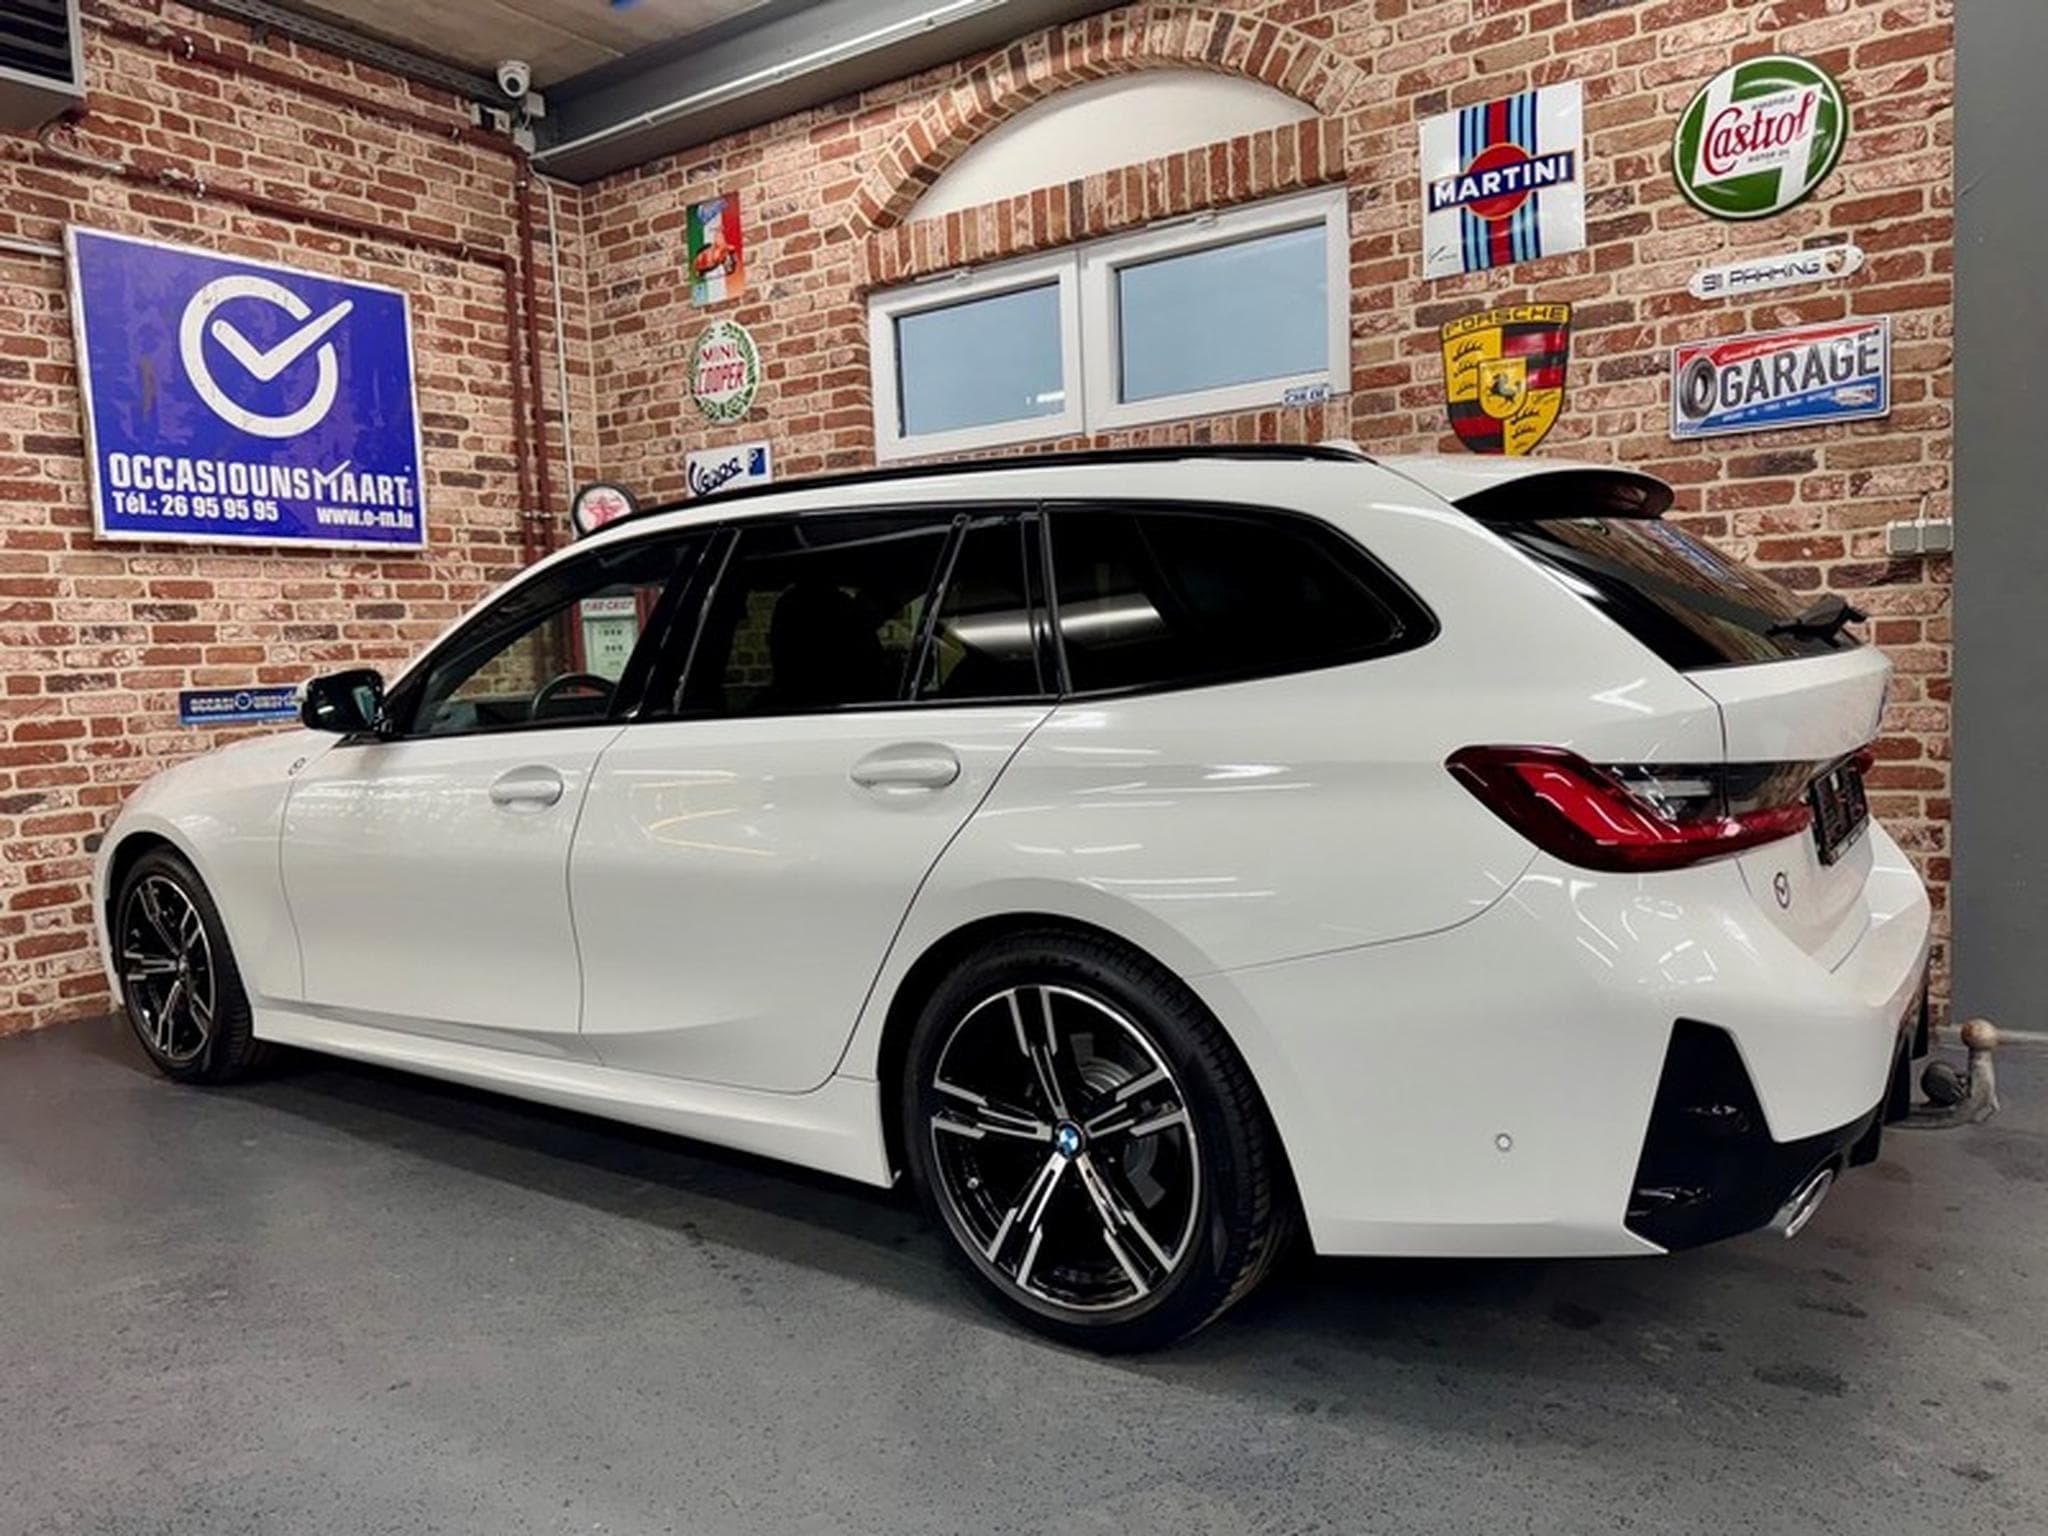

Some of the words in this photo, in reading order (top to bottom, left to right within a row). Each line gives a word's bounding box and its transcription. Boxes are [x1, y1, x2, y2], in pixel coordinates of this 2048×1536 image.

[1703, 90, 1816, 176] Castrol
[1434, 155, 1568, 208] MARTINI
[1444, 306, 1566, 337] PORSCHE
[702, 343, 737, 364] MINI
[1719, 328, 1880, 409] GARAGE
[697, 361, 745, 396] COOPER
[161, 495, 188, 518] 26
[192, 497, 219, 520] 95
[224, 499, 250, 521] 95
[253, 500, 279, 522] 95
